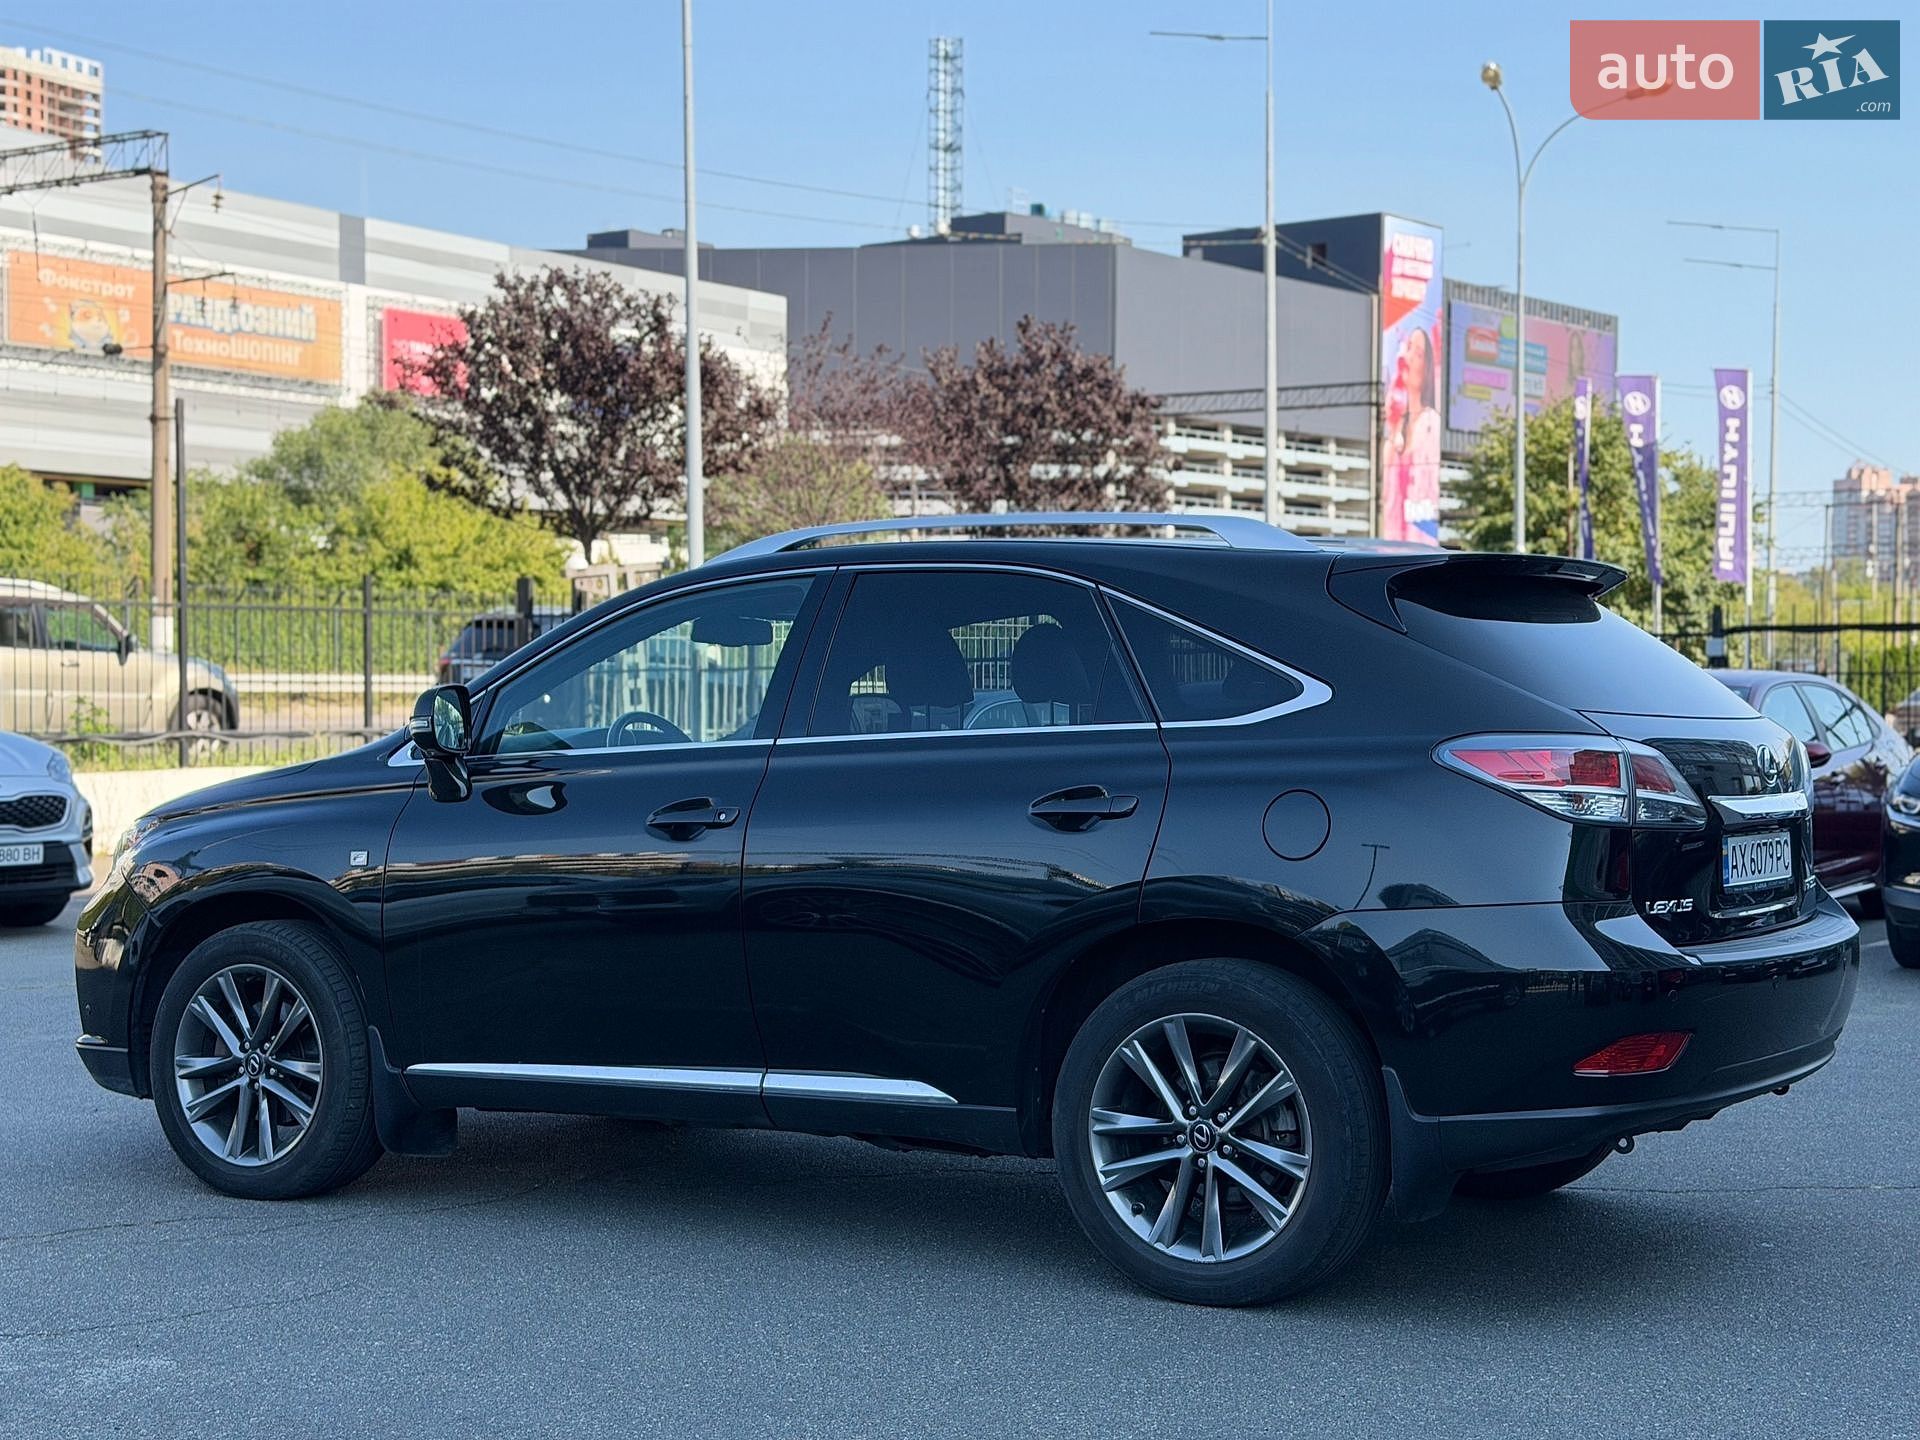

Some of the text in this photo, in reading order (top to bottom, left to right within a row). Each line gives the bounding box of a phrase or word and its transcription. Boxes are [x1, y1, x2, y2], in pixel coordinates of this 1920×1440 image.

[38, 267, 136, 299] Фокстрот
[1717, 417, 1741, 571] HYUNDAI
[23, 847, 40, 861] BH
[1730, 844, 1748, 879] AX
[1750, 840, 1774, 876] 6079
[1645, 898, 1693, 914] LEXUS
